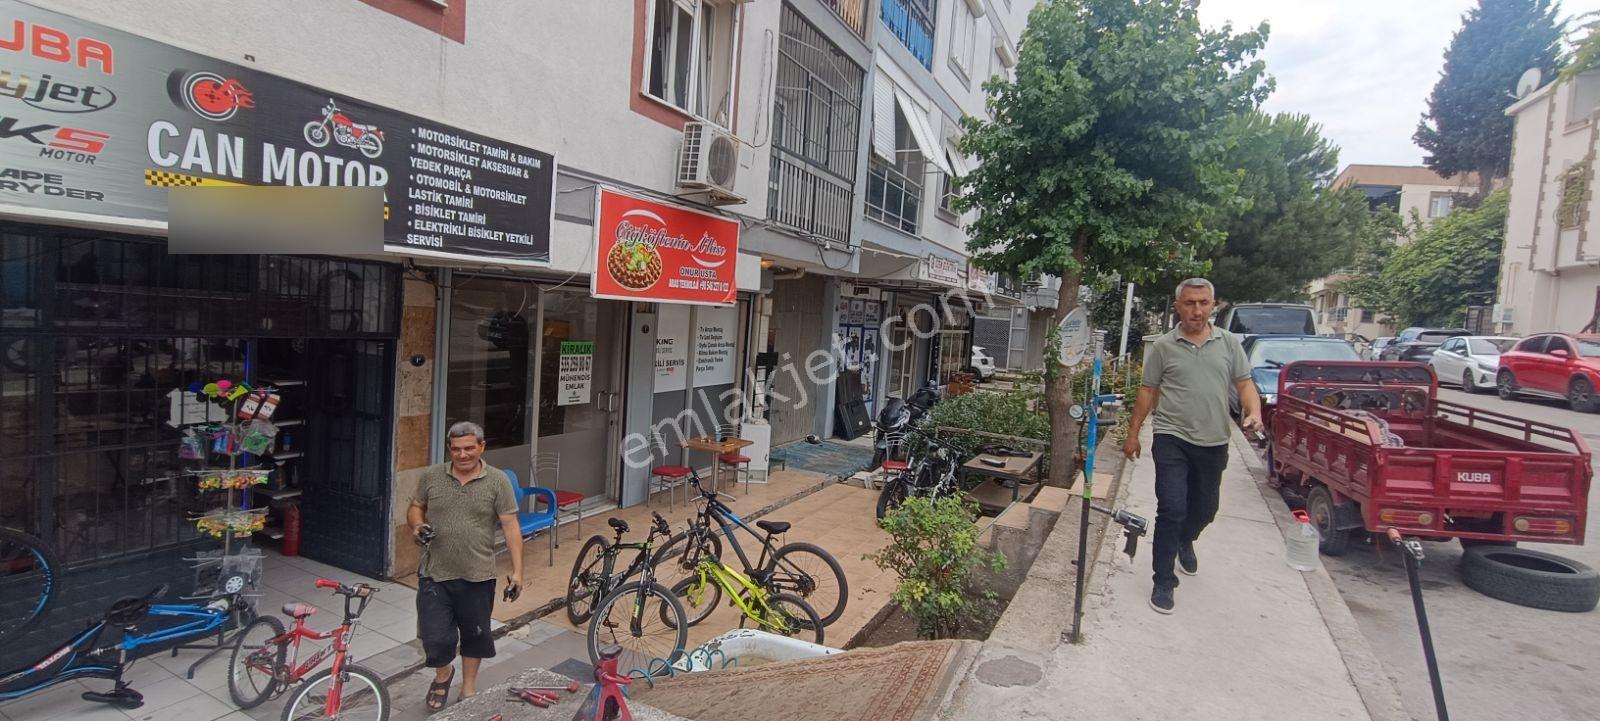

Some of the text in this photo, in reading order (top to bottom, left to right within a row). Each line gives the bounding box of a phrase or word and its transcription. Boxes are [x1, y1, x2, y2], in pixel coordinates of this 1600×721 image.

[39, 147, 96, 165] MOTOR
[147, 120, 244, 178] CAN
[418, 127, 541, 168] MOTORSİKLET TAMİRİ & BAKIM
[410, 156, 472, 180] YEDEK PARÇA
[417, 143, 529, 179] MOTORSİKLET AKSESUAR &
[408, 187, 474, 209] LASTİK TAMİRİ
[416, 174, 527, 205] OTOMOBİL & MOTORSİKLET
[415, 203, 486, 225] BİSİKLET TAMİRİ
[406, 234, 443, 248] SERVİSİ
[414, 219, 534, 245] ELEKTRİKLİ BİSİKLET YETKİLİ
[679, 266, 717, 279] ONUR USTA
[561, 343, 592, 355] KİRALIK
[560, 373, 591, 382] MÜHENDİS
[1457, 472, 1491, 483] KUBA
